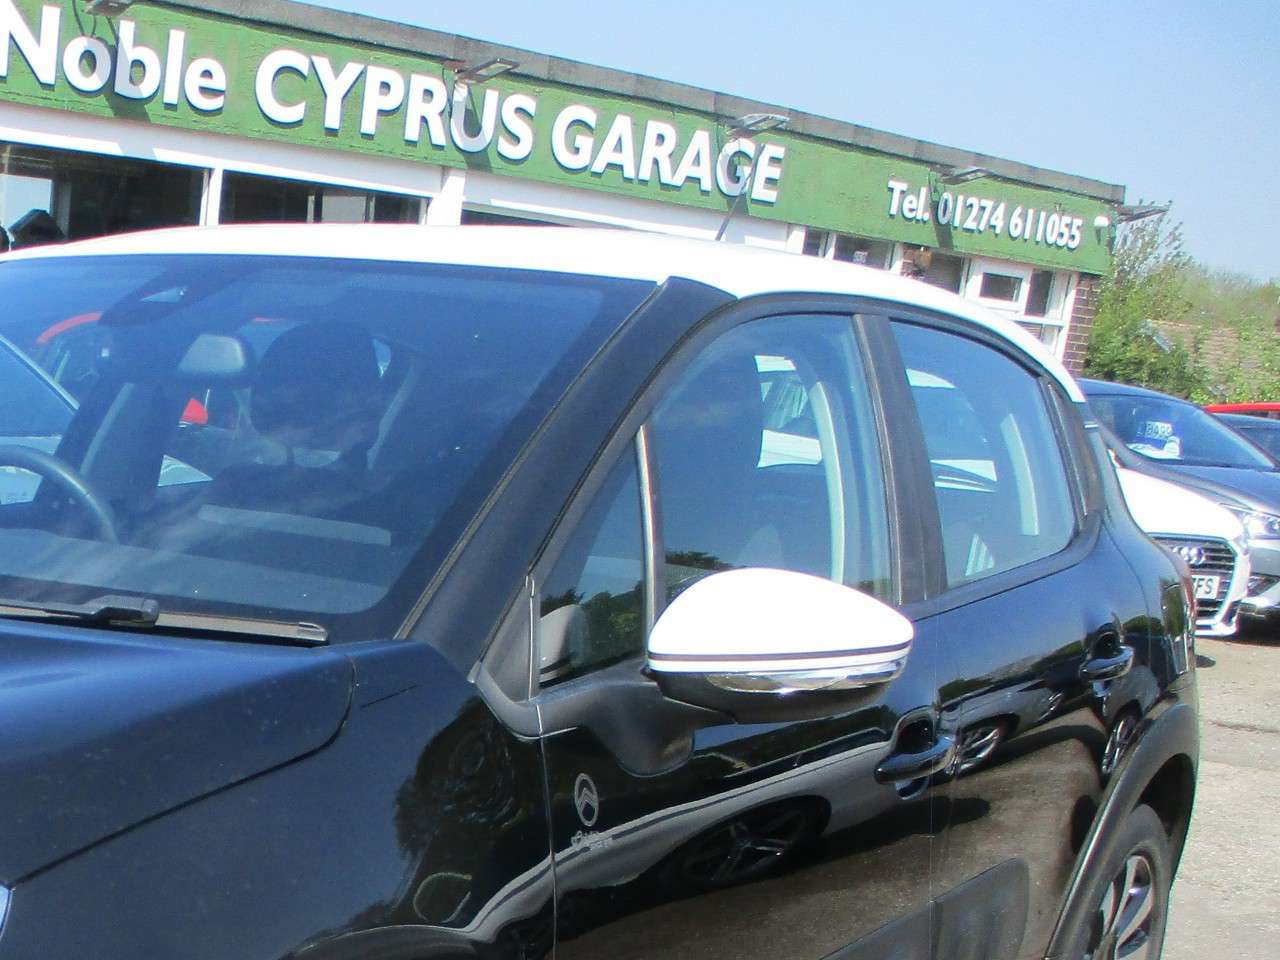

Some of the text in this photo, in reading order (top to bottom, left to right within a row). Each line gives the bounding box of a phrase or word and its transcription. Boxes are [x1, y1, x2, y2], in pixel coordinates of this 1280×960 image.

[255, 49, 537, 160] CYPRUS
[551, 104, 786, 203] GARAGE
[887, 180, 1084, 249] Tel. 01274 611055
